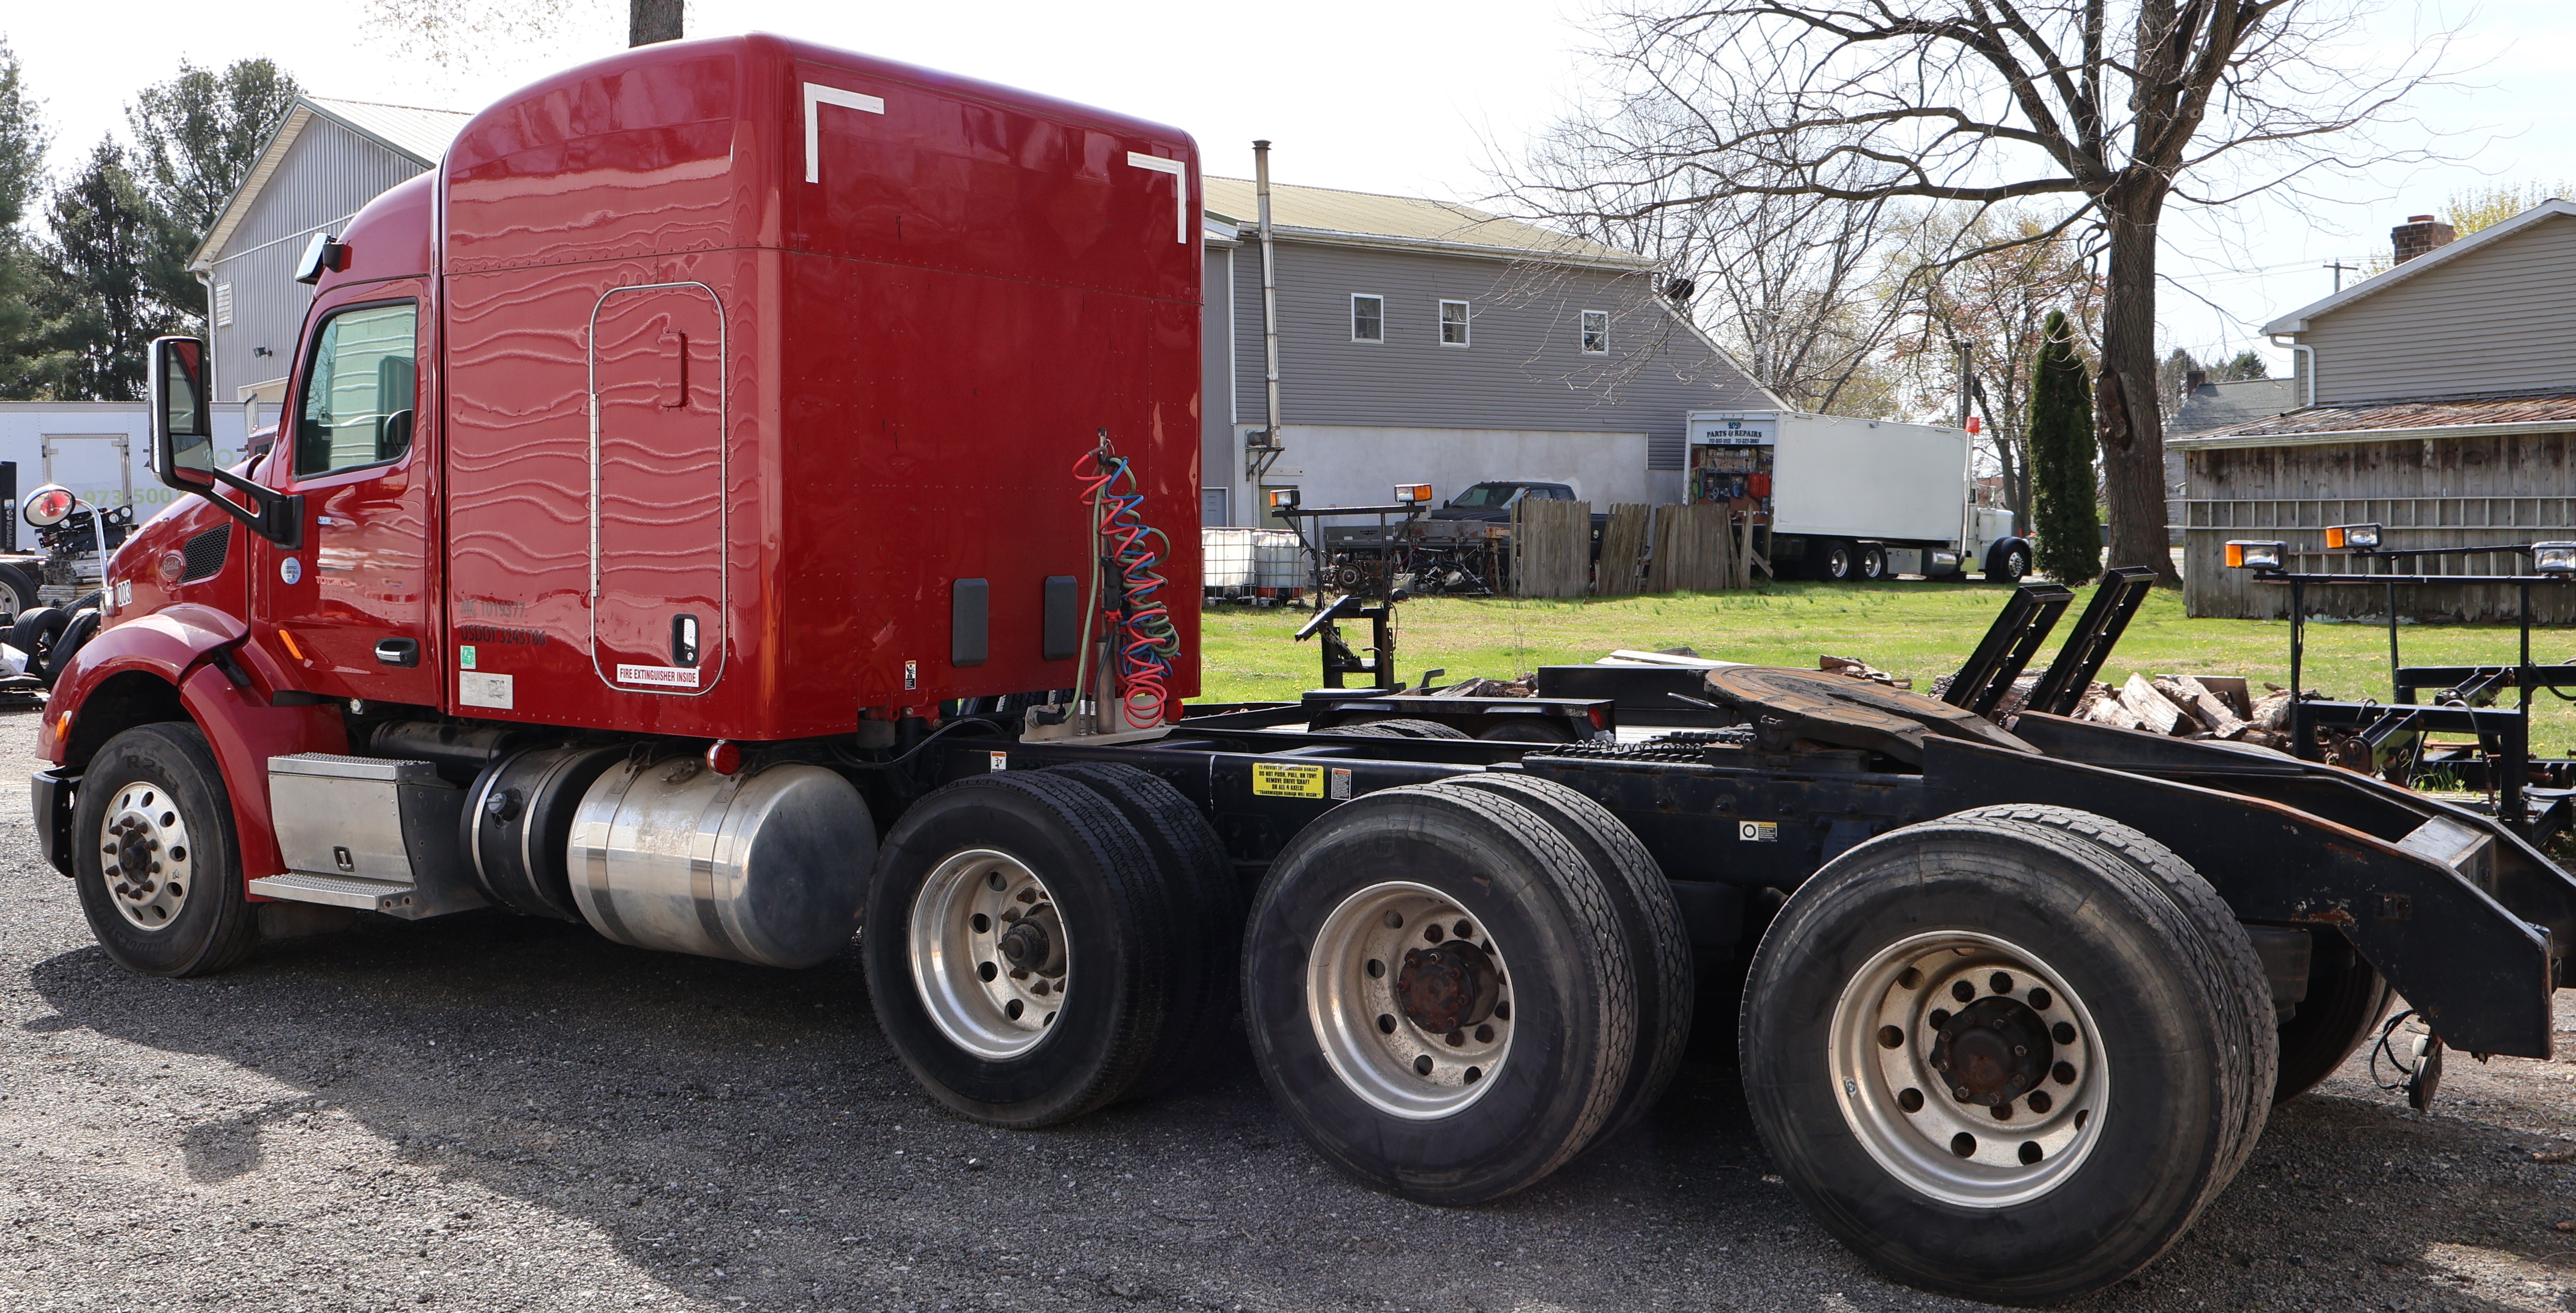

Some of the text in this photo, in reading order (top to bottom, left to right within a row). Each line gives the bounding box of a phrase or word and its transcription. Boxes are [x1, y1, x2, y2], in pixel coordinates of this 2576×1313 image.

[83, 490, 123, 506] 973
[133, 488, 173, 504] 500
[118, 581, 131, 605] 003
[461, 599, 526, 618] MC 1019377
[461, 625, 547, 646] USDOT 3243786
[620, 668, 696, 683] FIRE EXTINGUISHER INSIDE
[126, 755, 180, 793] R213
